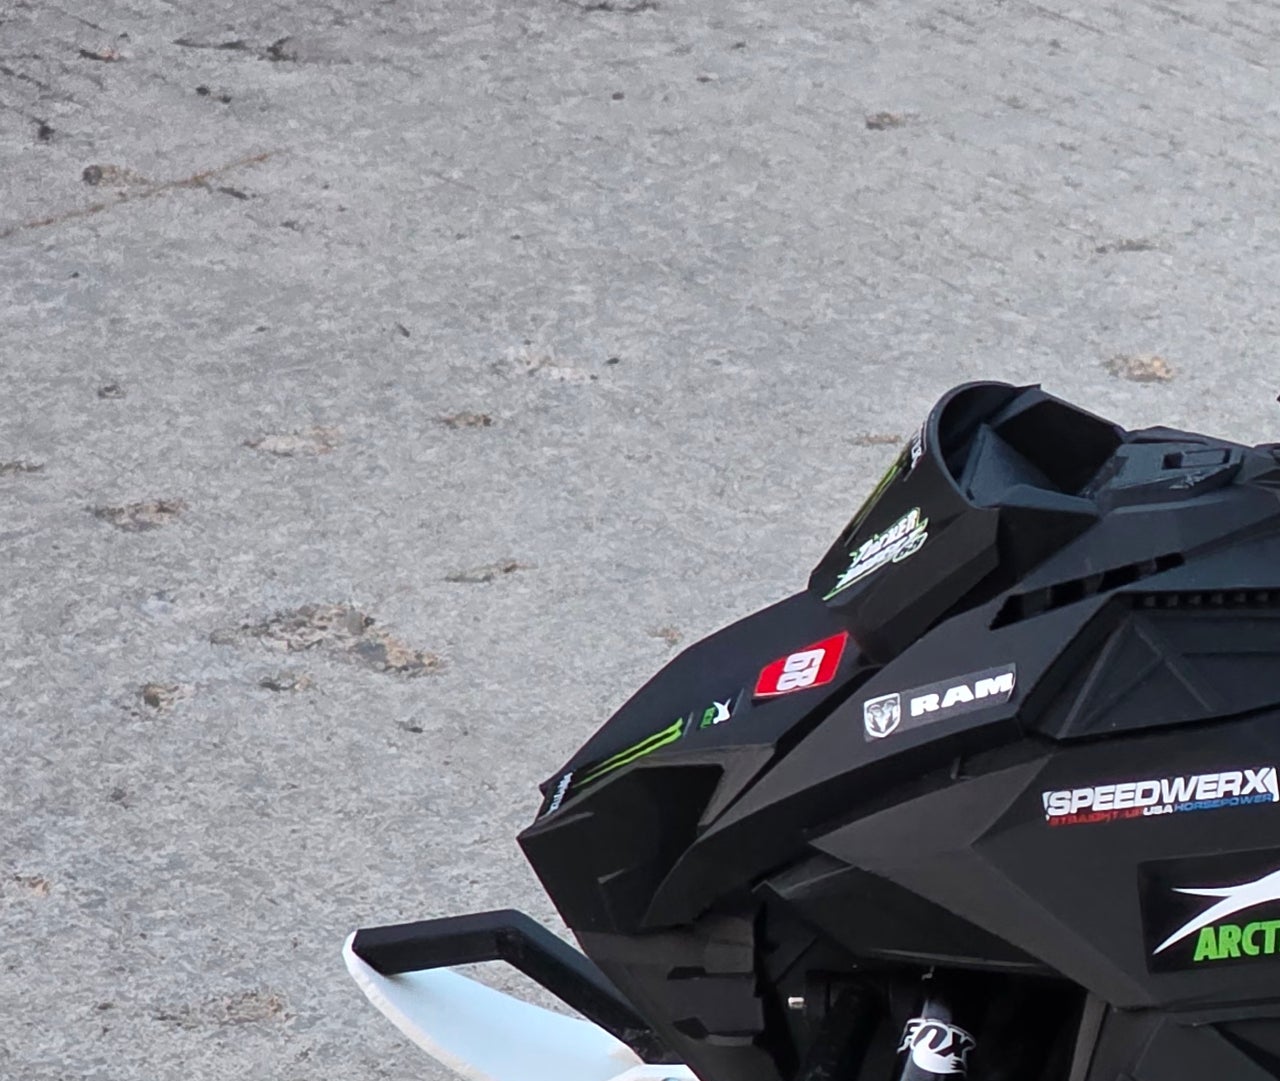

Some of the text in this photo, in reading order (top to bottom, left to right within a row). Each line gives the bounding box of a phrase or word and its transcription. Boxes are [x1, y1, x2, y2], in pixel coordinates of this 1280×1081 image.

[777, 649, 825, 690] 68
[911, 673, 1013, 716] RAM
[1047, 768, 1271, 816] SPEEDWERX
[1143, 804, 1173, 816] USA
[1174, 793, 1273, 812] HORSEPOWER
[897, 1018, 976, 1074] FOX
